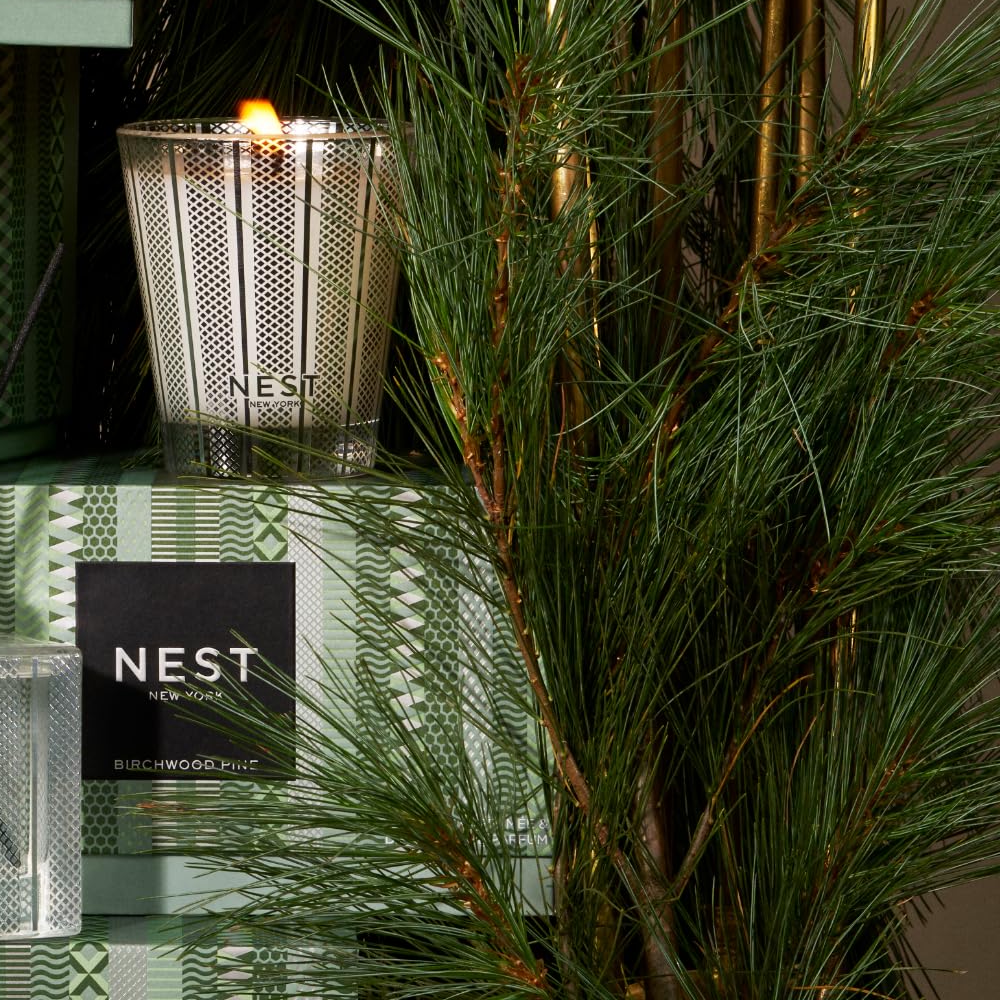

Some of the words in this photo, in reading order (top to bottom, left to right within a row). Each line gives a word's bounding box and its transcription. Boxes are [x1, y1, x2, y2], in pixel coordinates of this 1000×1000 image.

[229, 374, 321, 397] NEST
[274, 400, 300, 408] YORK
[115, 647, 259, 683] NEST
[149, 691, 180, 701] NEW
[114, 759, 215, 771] BIRCHWOOD
